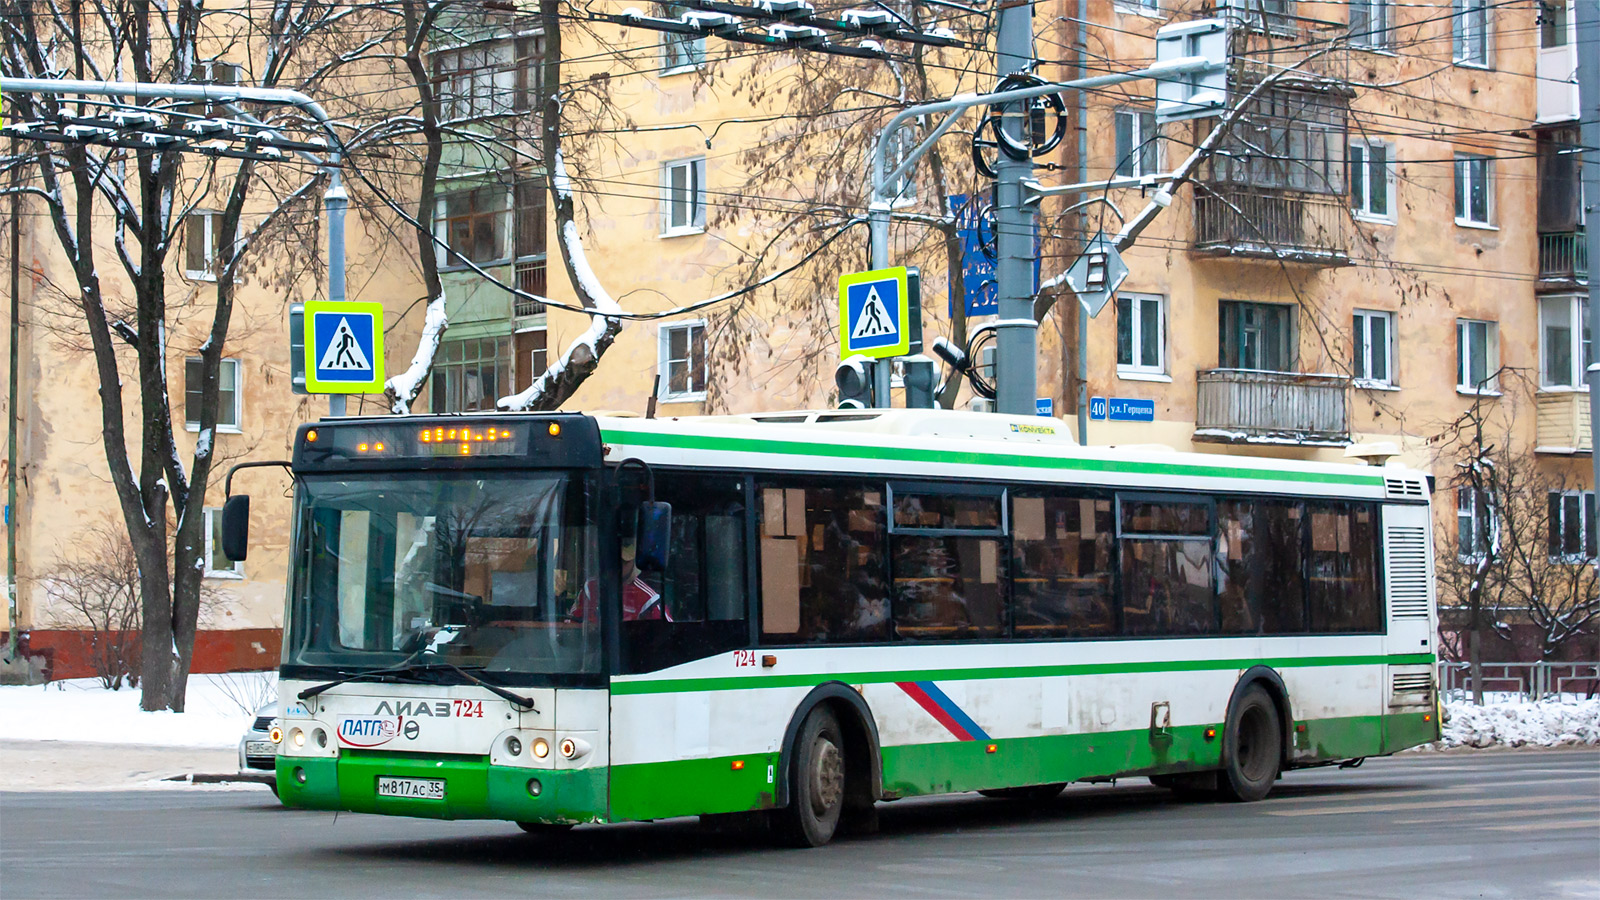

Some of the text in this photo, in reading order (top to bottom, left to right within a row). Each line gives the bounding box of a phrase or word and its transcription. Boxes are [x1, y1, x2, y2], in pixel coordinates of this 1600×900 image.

[1092, 402, 1105, 416] 40
[1111, 403, 1153, 416] ул. Герцена
[733, 649, 756, 668] 724
[374, 701, 451, 717] ЛИАЗ
[453, 700, 484, 718] 724
[382, 780, 440, 796] М817АС 35
